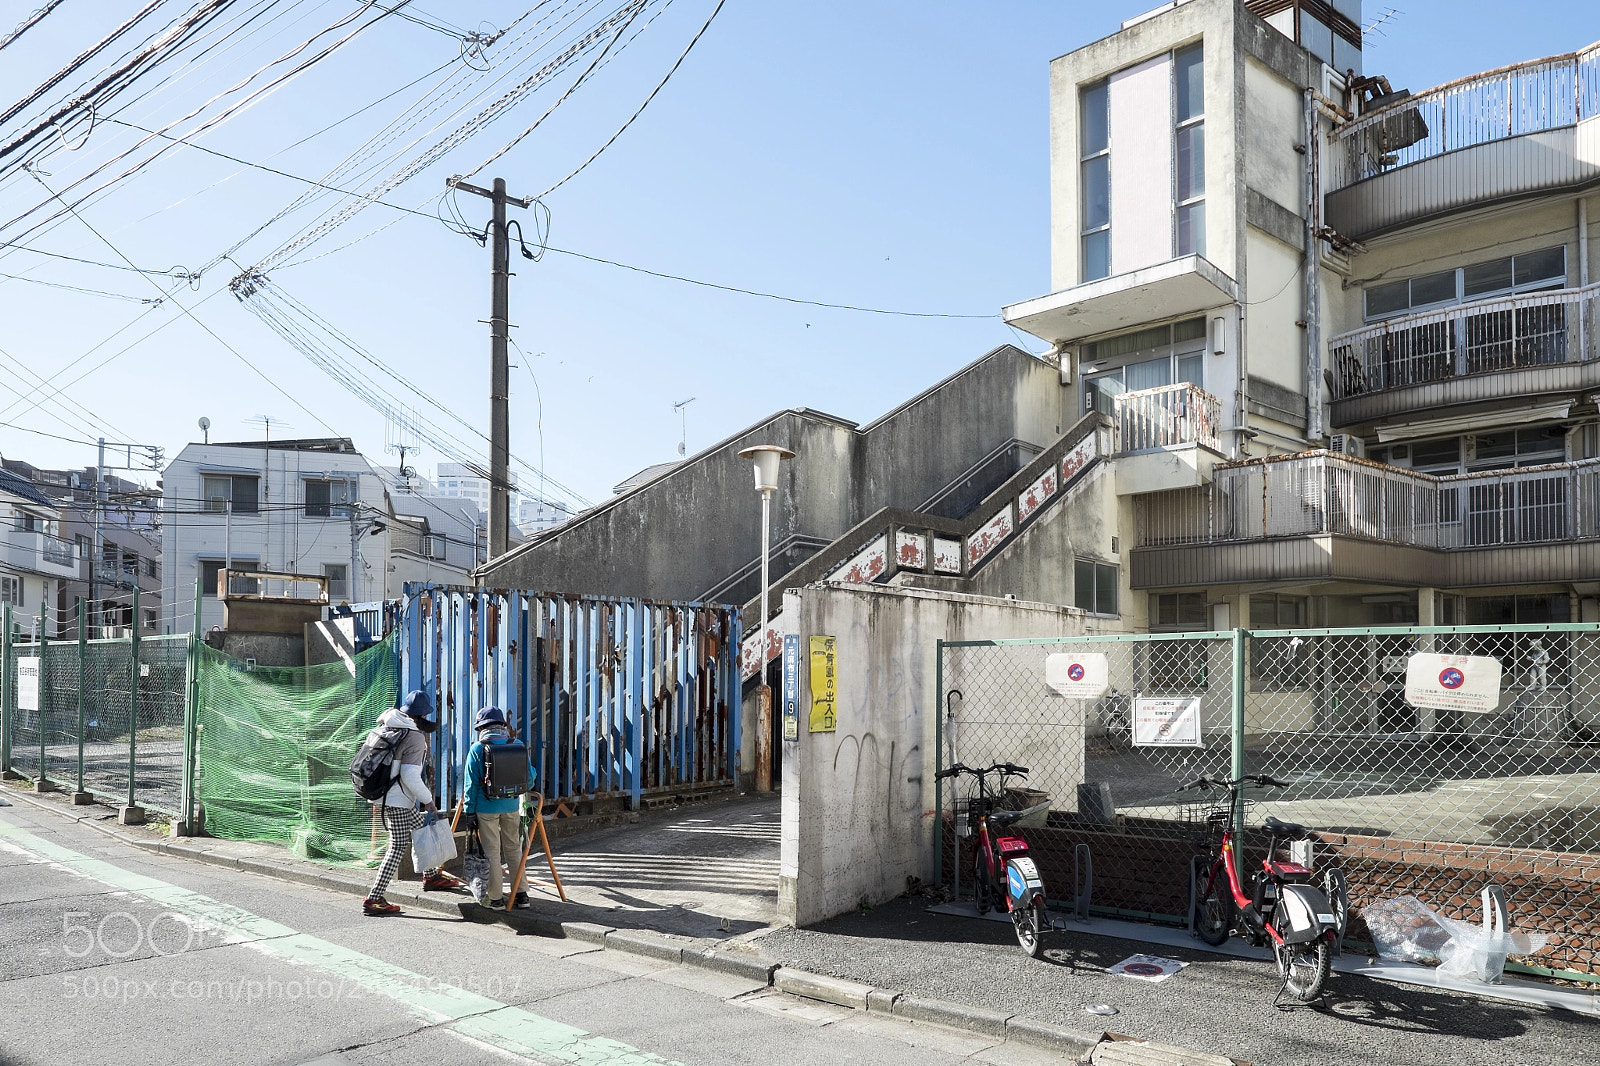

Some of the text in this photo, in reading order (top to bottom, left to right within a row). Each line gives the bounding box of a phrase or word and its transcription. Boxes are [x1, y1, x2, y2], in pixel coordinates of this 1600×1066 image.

[787, 646, 795, 699] 元麻布三丁目
[824, 639, 835, 729] 保育園の出入口
[788, 702, 794, 714] 9
